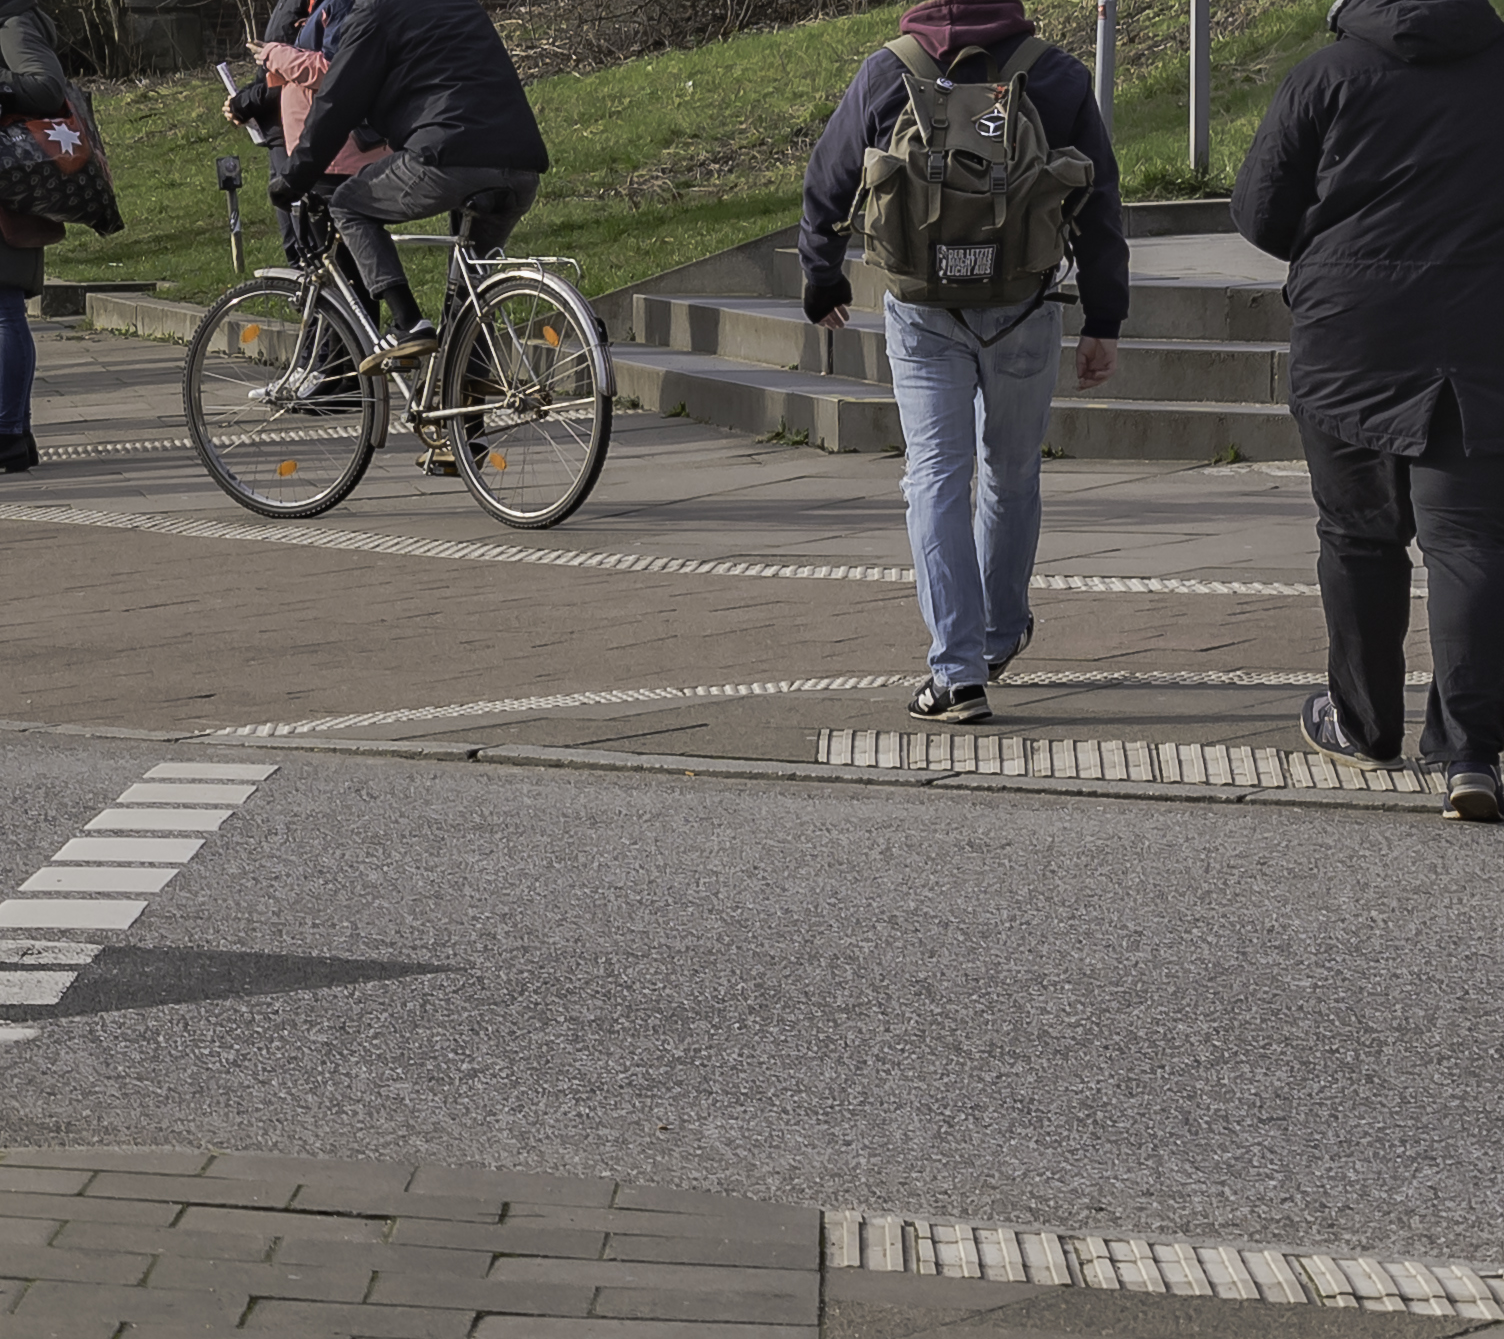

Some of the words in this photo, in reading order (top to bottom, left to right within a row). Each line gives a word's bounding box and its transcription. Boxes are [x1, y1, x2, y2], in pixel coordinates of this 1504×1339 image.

[948, 249, 964, 258] DER
[966, 248, 993, 258] LETZTE
[948, 256, 975, 266] MACHT
[947, 265, 971, 276] LICHT
[973, 264, 991, 275] AUS
